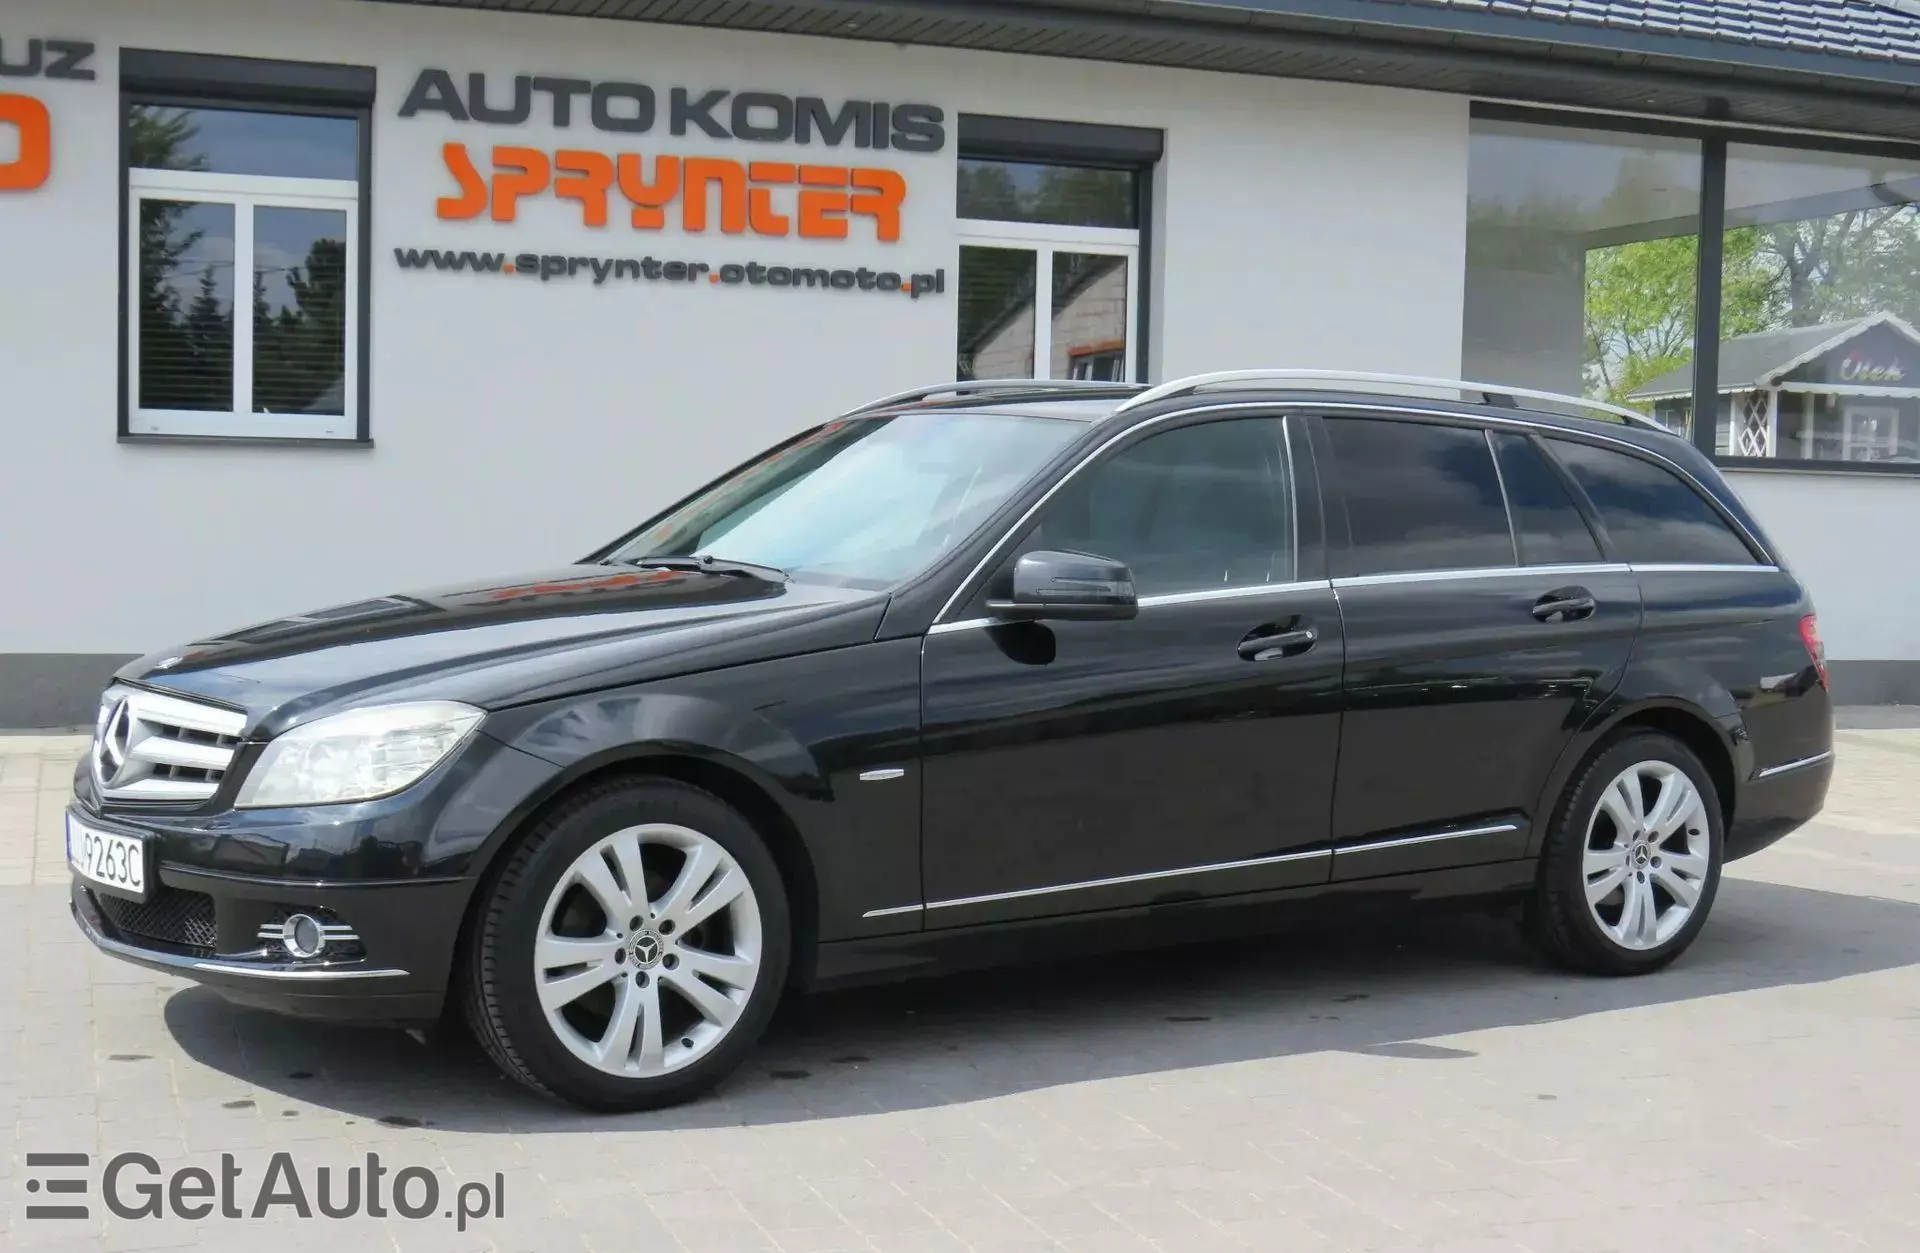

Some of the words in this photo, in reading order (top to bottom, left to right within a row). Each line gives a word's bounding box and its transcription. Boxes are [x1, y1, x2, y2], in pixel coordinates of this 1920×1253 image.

[398, 69, 655, 133] AUTO
[669, 87, 945, 152] KOMIS
[436, 143, 907, 242] SPRYNTER
[394, 248, 945, 299] www.sprynter.otomoto.pl
